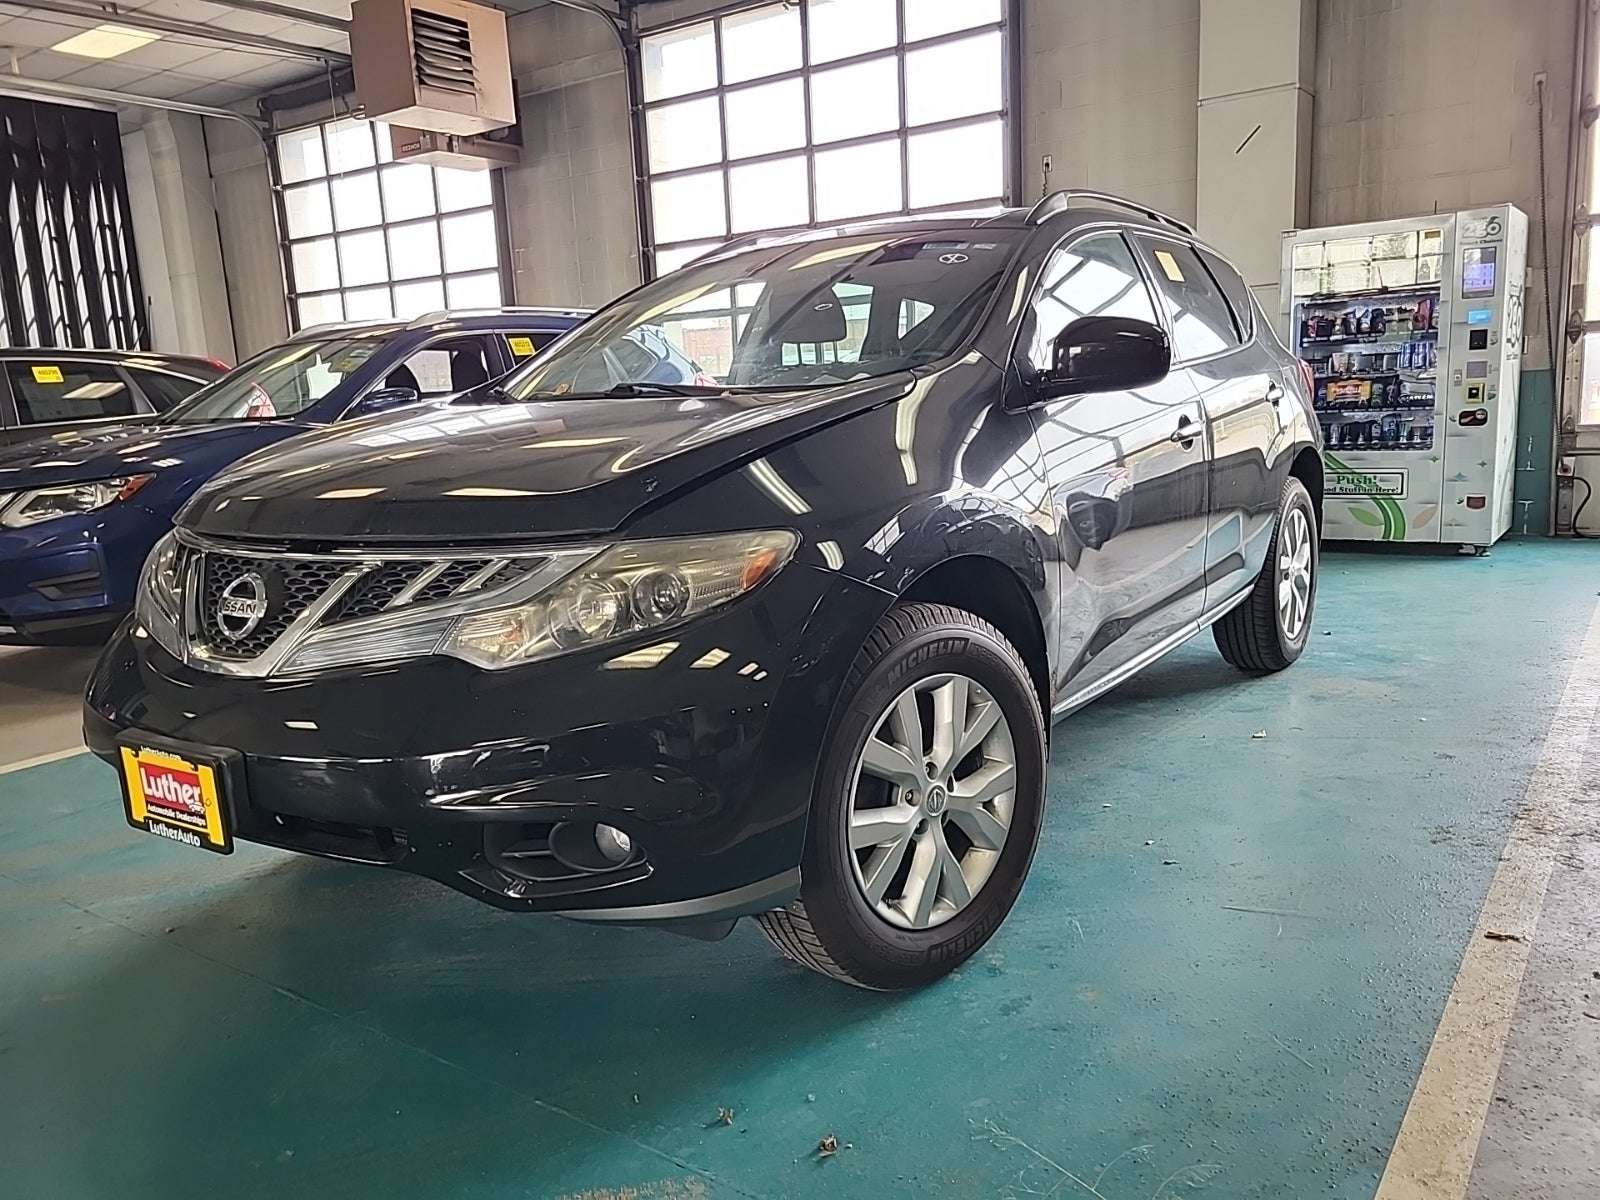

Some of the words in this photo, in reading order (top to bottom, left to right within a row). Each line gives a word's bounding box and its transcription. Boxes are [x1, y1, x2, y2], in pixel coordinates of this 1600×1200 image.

[1323, 486, 1337, 494] ood
[1376, 486, 1399, 494] Here!
[1336, 475, 1377, 485] Push!
[220, 601, 257, 613] SSAN
[887, 639, 966, 690] MICHELIN
[140, 767, 201, 806] Luther
[148, 819, 201, 847] LutherAuto
